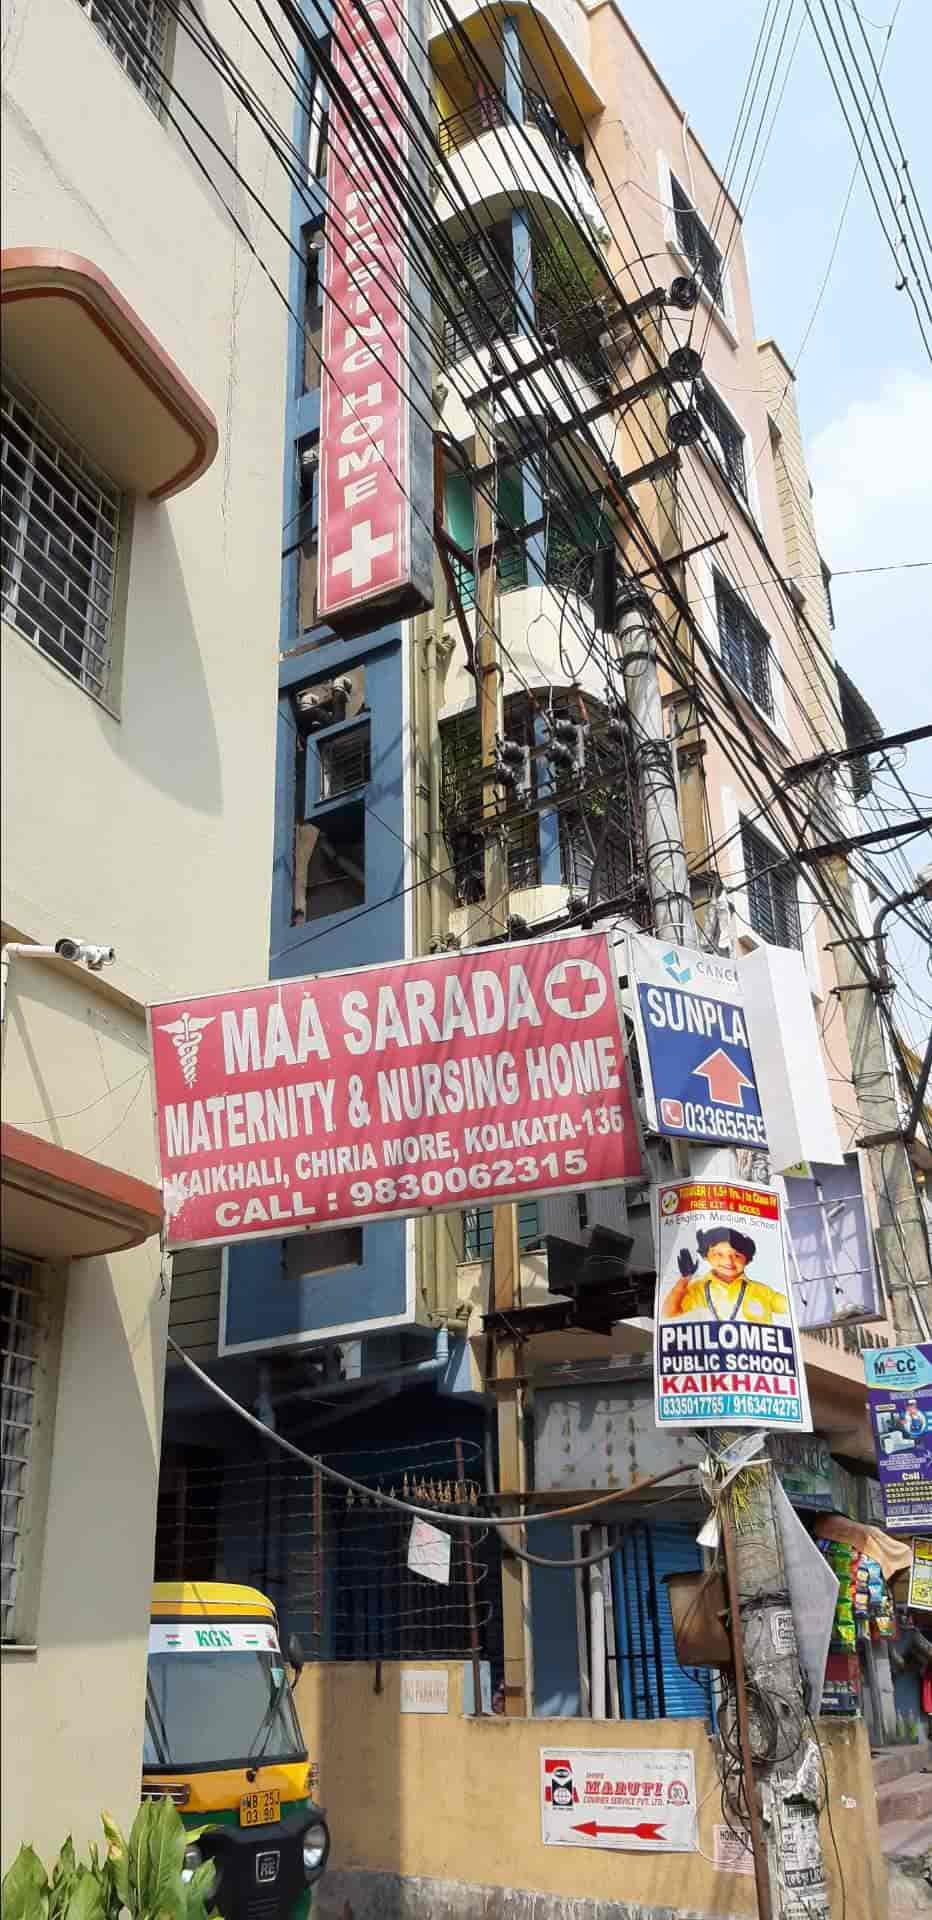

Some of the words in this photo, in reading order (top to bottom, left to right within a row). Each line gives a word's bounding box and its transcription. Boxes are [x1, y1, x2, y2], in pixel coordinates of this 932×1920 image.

[337, 381, 386, 510] HOME
[341, 964, 542, 1056] SARADA
[647, 988, 749, 1048] SUNPLA
[164, 1078, 337, 1158] MATERNITY
[349, 1074, 371, 1129] &
[377, 1050, 520, 1124] NURSING
[524, 1036, 621, 1101] HOME
[171, 1156, 290, 1199] KAIKHALI,
[295, 1144, 378, 1180] CHIRIA
[383, 1131, 459, 1167] MORE,
[463, 1105, 625, 1155] KOLKATA-136
[215, 1191, 316, 1228] CALL
[327, 1192, 338, 1213] :
[349, 1149, 588, 1207] 9830062315
[662, 1323, 793, 1354] PHILOMEL
[662, 1354, 720, 1373] PUBLIC
[725, 1353, 795, 1375] SCHOOL
[662, 1374, 797, 1396] KAIKHALI
[733, 1396, 799, 1418] 9163474275
[193, 1630, 233, 1647] KGN
[584, 1781, 663, 1797] MARUTI
